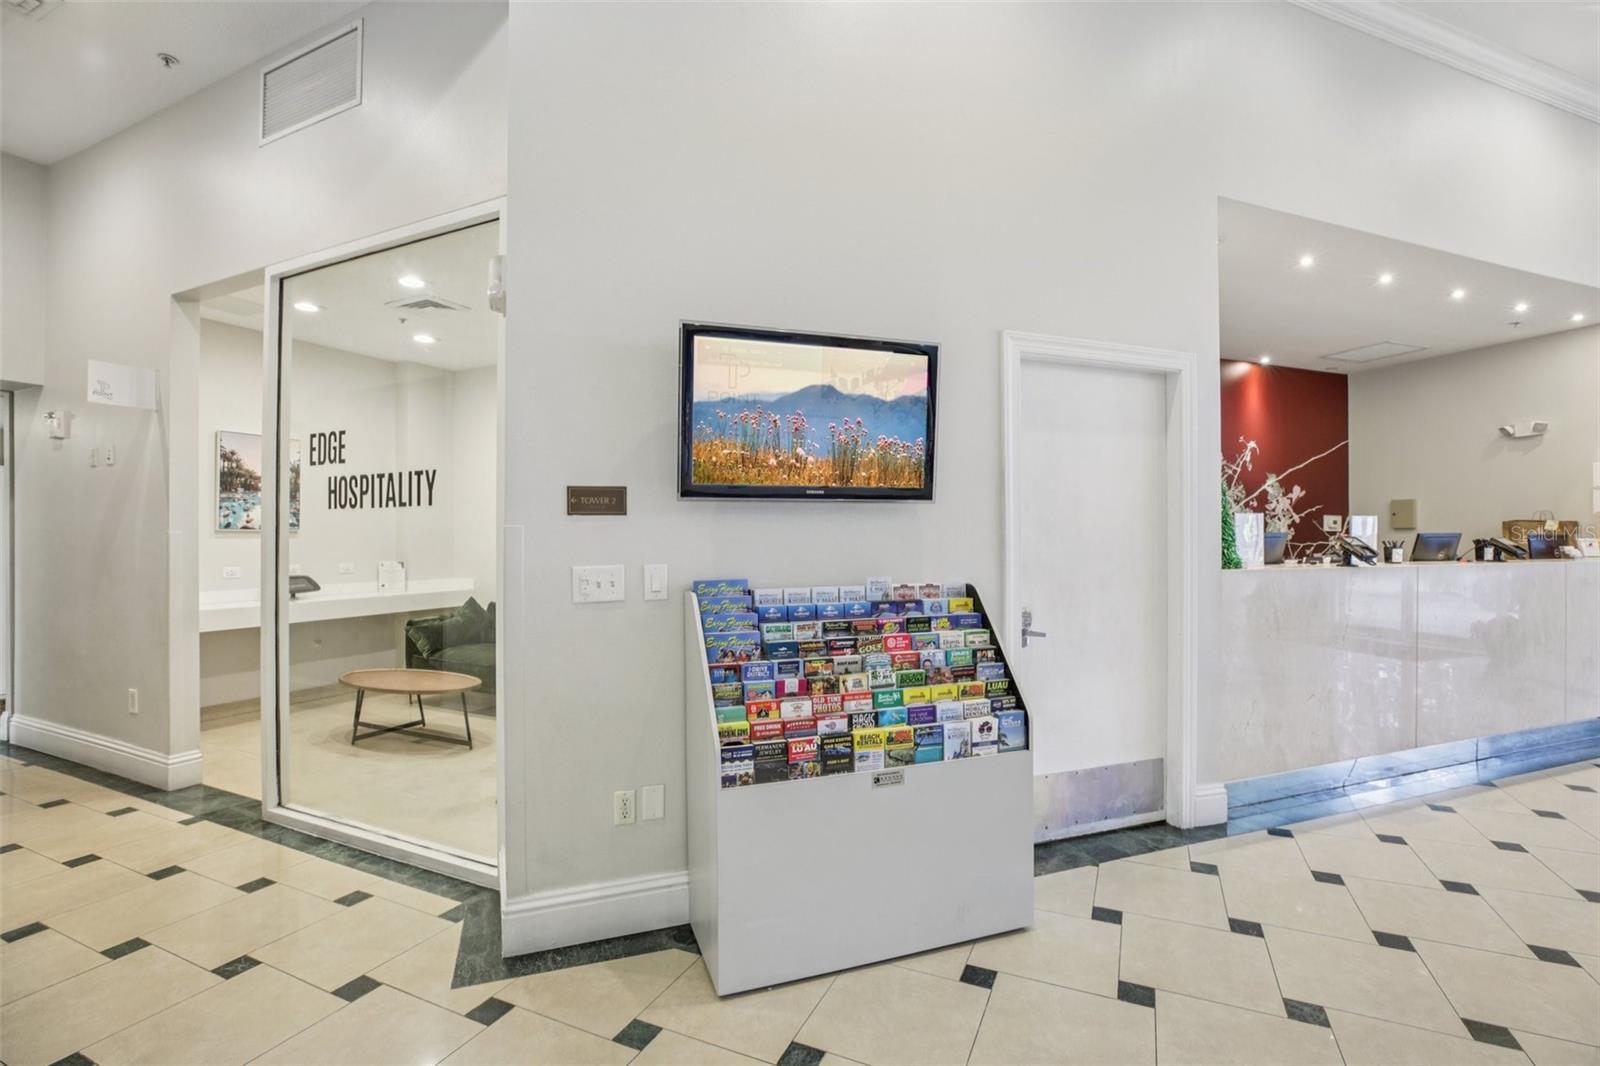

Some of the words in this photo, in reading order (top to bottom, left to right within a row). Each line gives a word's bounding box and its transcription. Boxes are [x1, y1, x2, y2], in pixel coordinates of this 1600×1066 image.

[309, 430, 346, 466] EDGE
[328, 469, 437, 509] HOSPITALITY
[580, 496, 610, 505] TOWER
[611, 496, 617, 505] 2
[859, 642, 884, 653] GOLF
[987, 681, 1009, 691] LUAU
[813, 703, 842, 714] PHOTOS
[852, 713, 876, 723] MAGIC
[860, 733, 881, 741] BEACH
